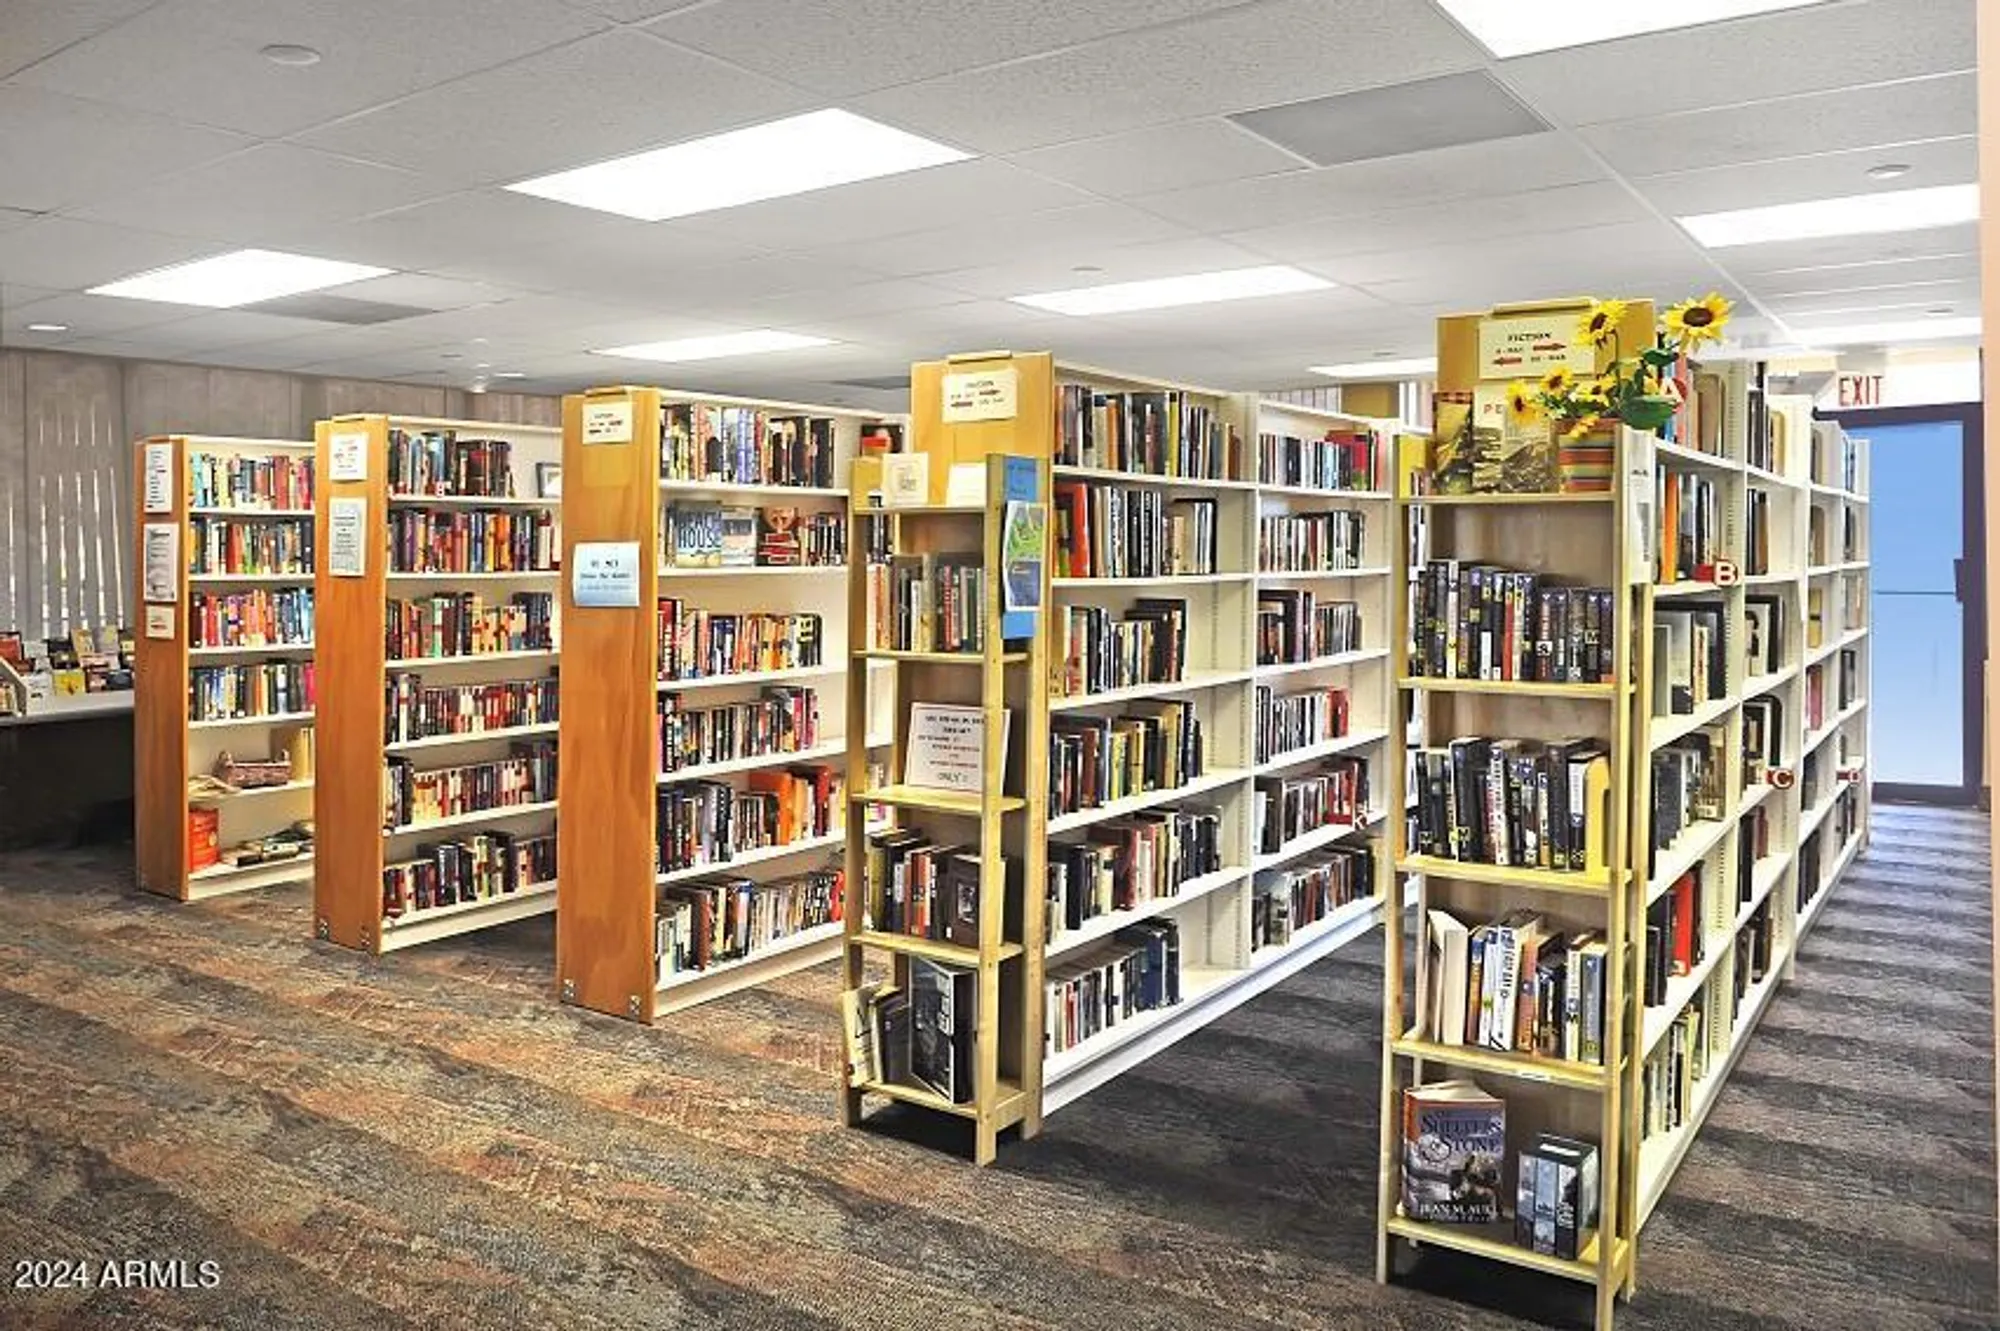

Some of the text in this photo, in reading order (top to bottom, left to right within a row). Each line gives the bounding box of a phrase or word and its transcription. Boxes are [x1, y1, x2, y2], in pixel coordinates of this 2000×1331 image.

[1507, 332, 1552, 342] FICTION
[1839, 375, 1884, 406] EXIT
[1714, 562, 1737, 585] B
[1773, 771, 1792, 788] C
[1442, 1133, 1500, 1152] STONE
